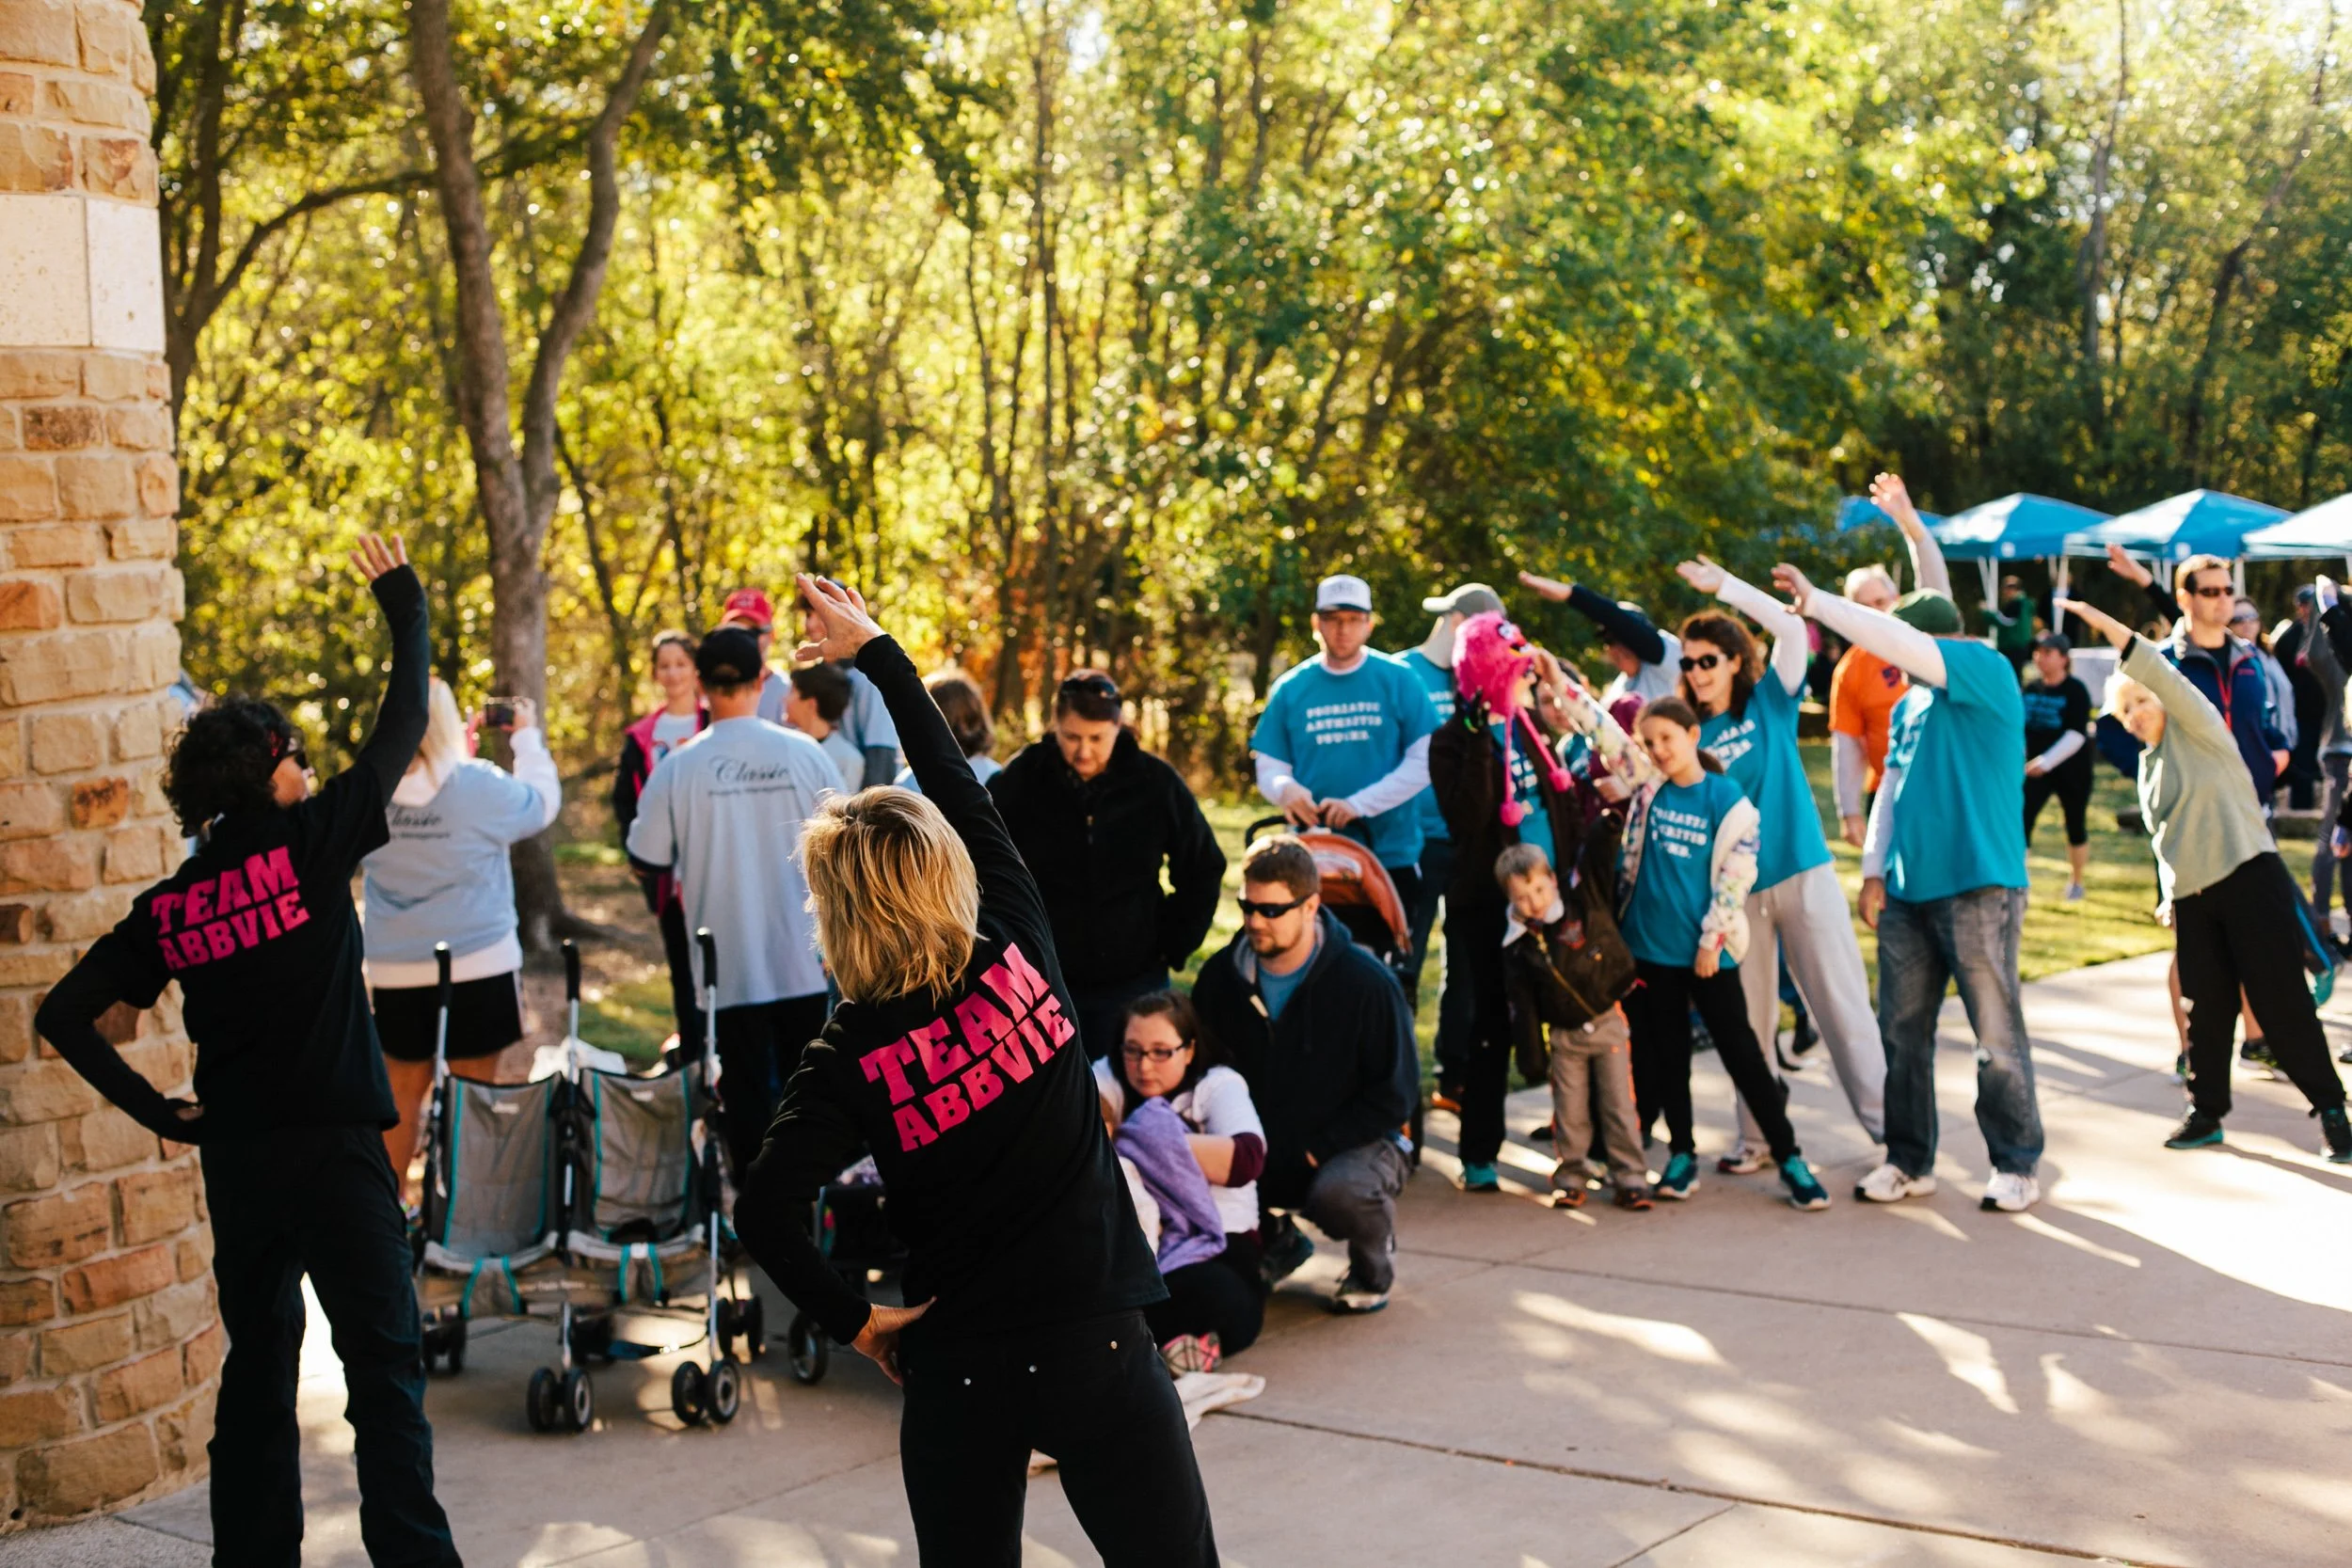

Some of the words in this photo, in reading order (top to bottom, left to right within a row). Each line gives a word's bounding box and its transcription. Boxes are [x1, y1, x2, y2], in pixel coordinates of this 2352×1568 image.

[391, 806, 442, 827] lassic
[151, 846, 299, 935] TEAM
[158, 889, 310, 971] ABBVIE
[859, 942, 1050, 1105] TEAM
[893, 993, 1075, 1152] ABBVIE
